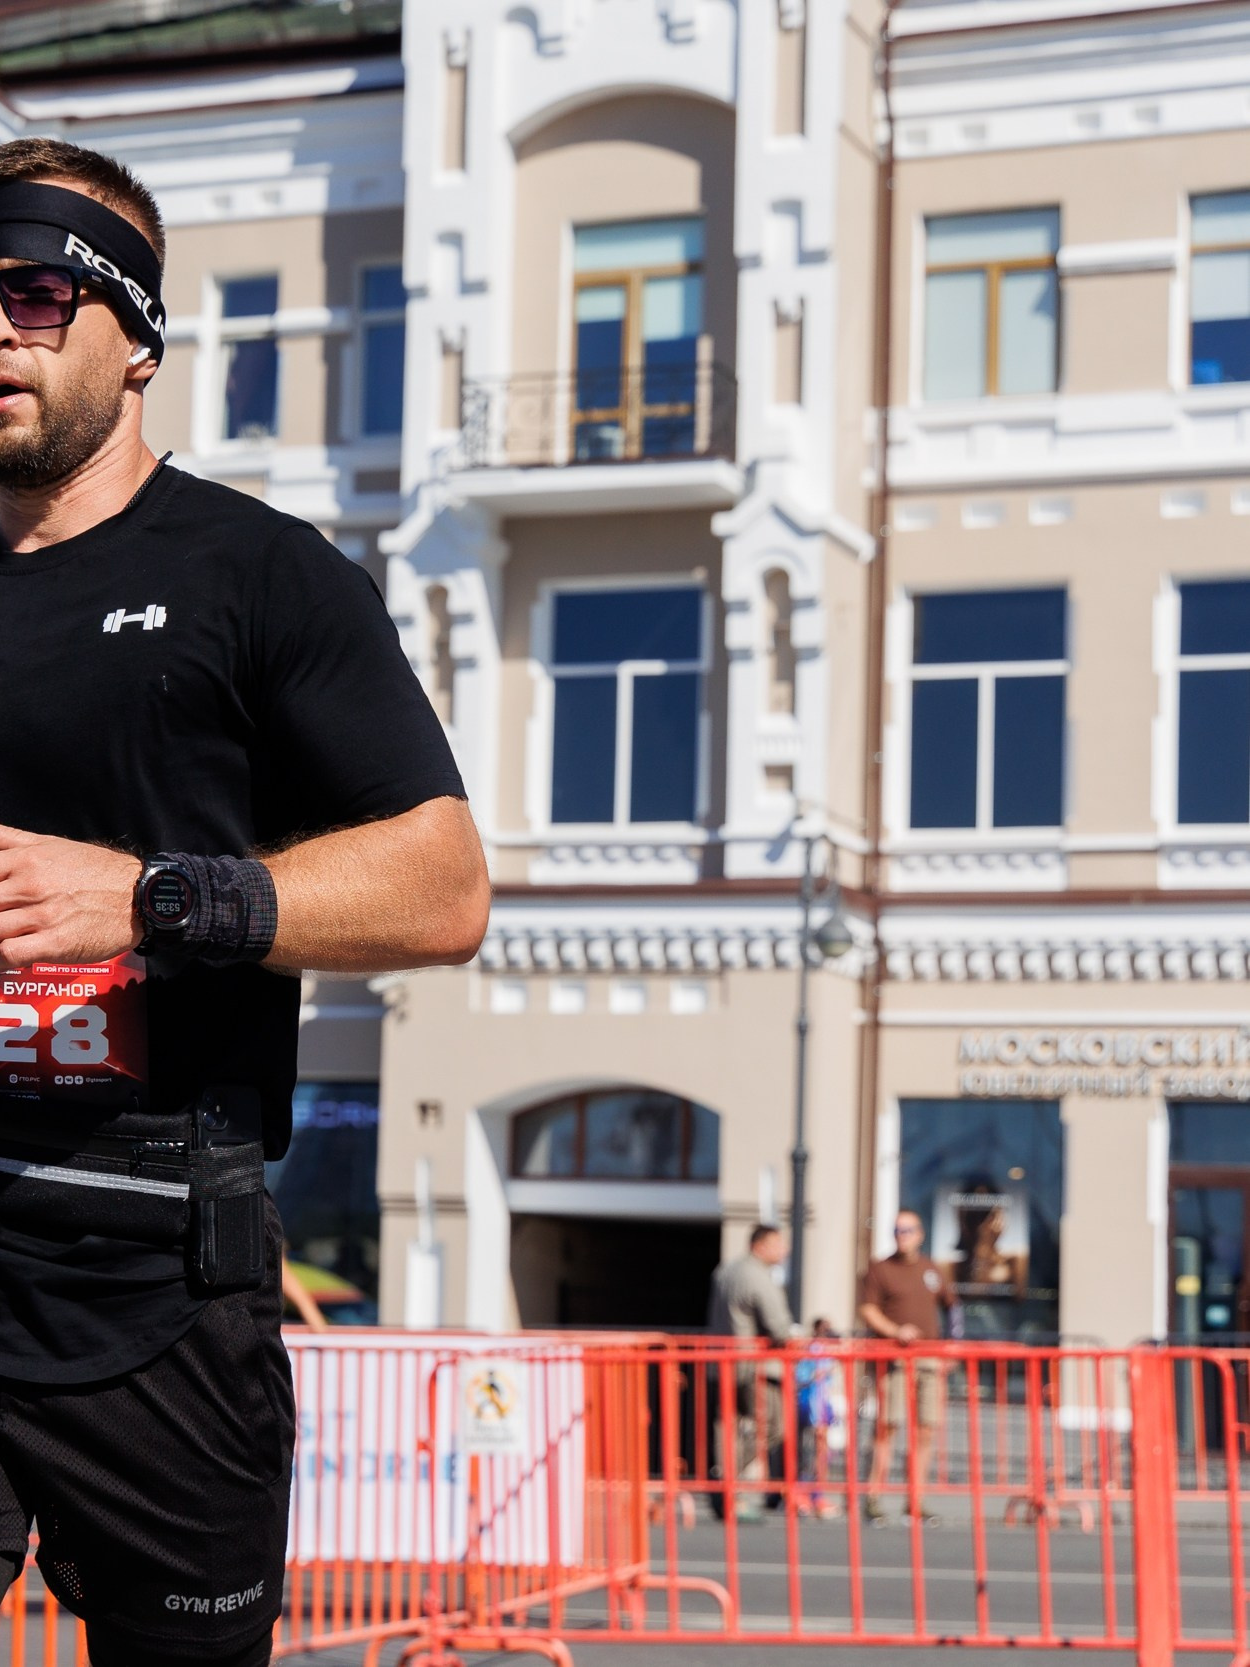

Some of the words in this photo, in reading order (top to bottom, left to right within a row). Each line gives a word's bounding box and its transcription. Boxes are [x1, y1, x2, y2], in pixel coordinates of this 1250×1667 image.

[64, 233, 165, 343] ROGU
[155, 902, 180, 912] 53:35
[3, 982, 97, 997] БУРГАНОВ
[164, 1594, 210, 1614] GYM
[214, 1580, 264, 1614] REVIVE
